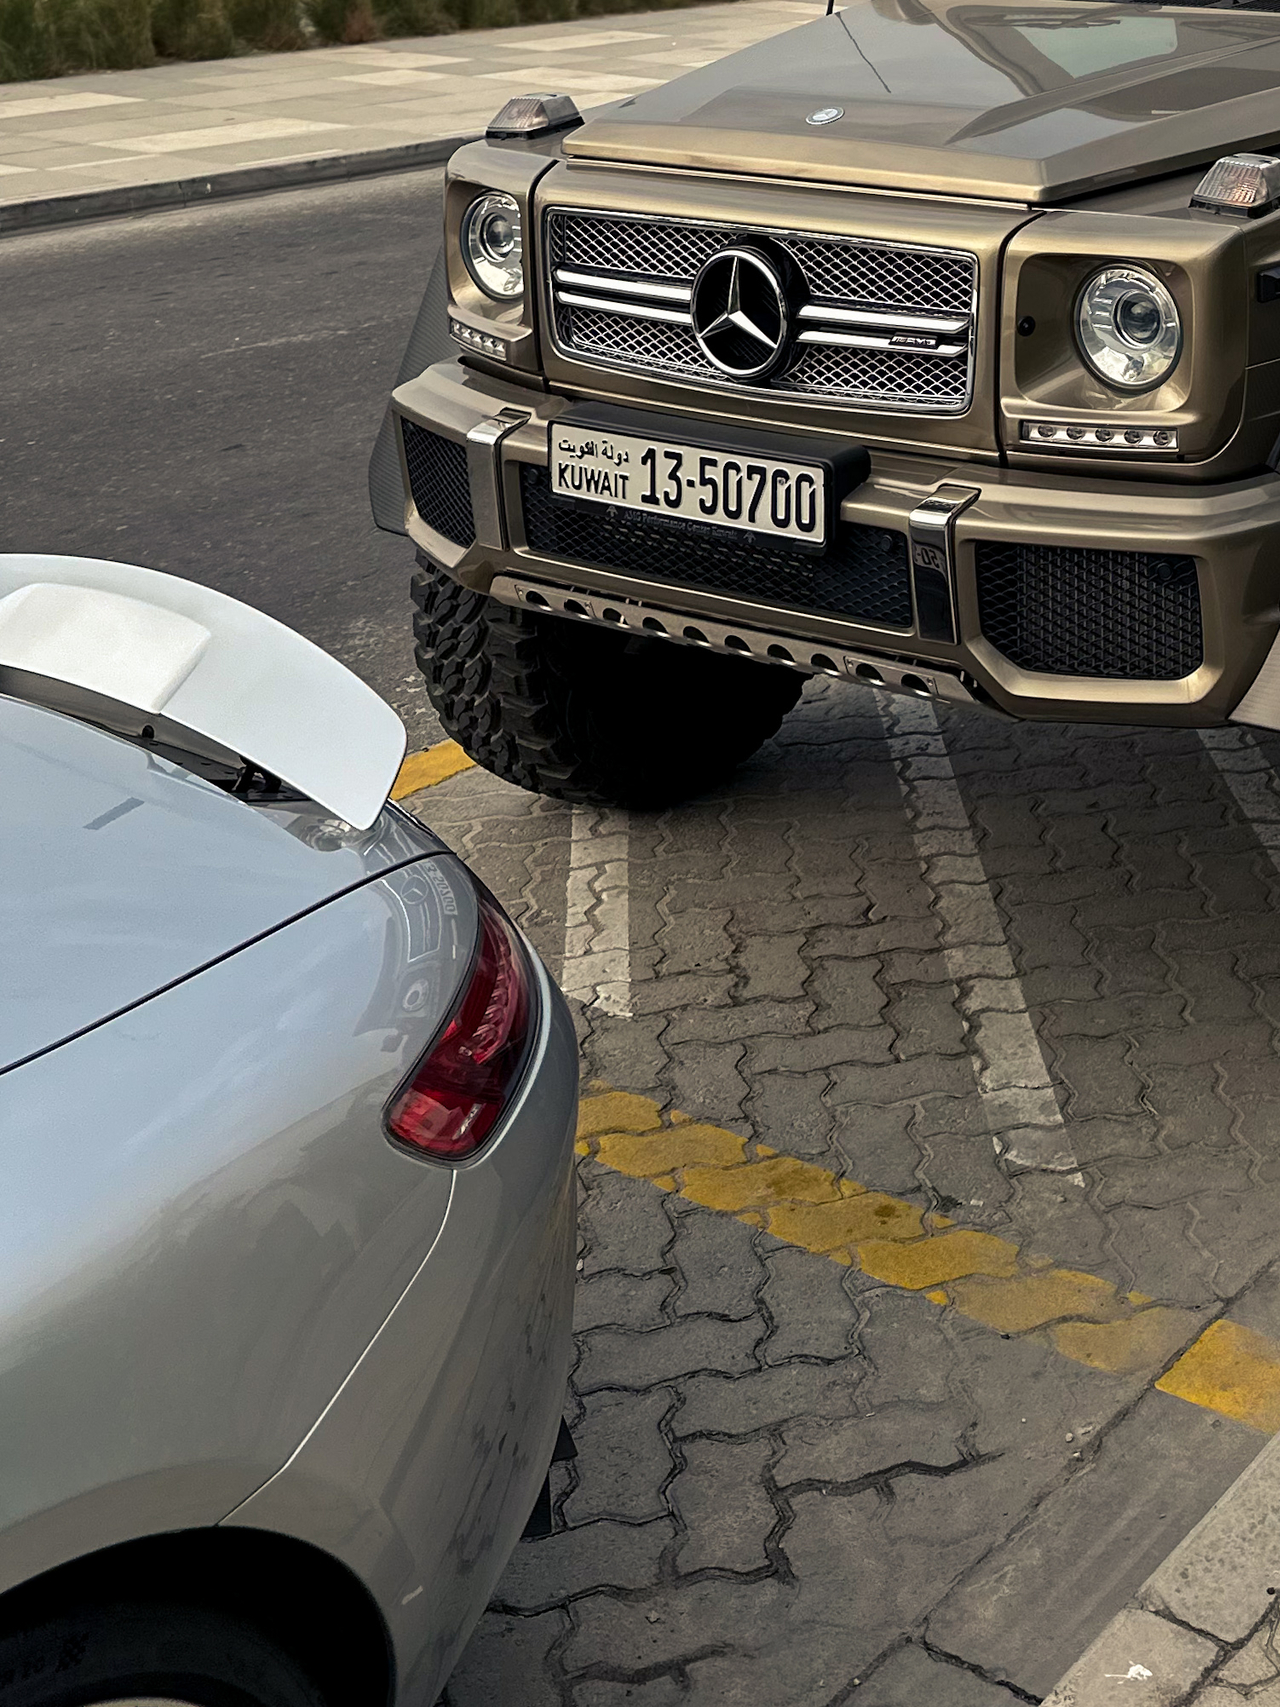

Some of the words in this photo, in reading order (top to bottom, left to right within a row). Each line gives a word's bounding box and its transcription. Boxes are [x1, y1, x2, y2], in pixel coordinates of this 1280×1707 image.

[558, 438, 598, 460] الكويت
[601, 439, 629, 464] دولة
[557, 462, 630, 500] KUWAIT
[640, 446, 816, 533] 13-50700
[642, 512, 686, 531] Performance
